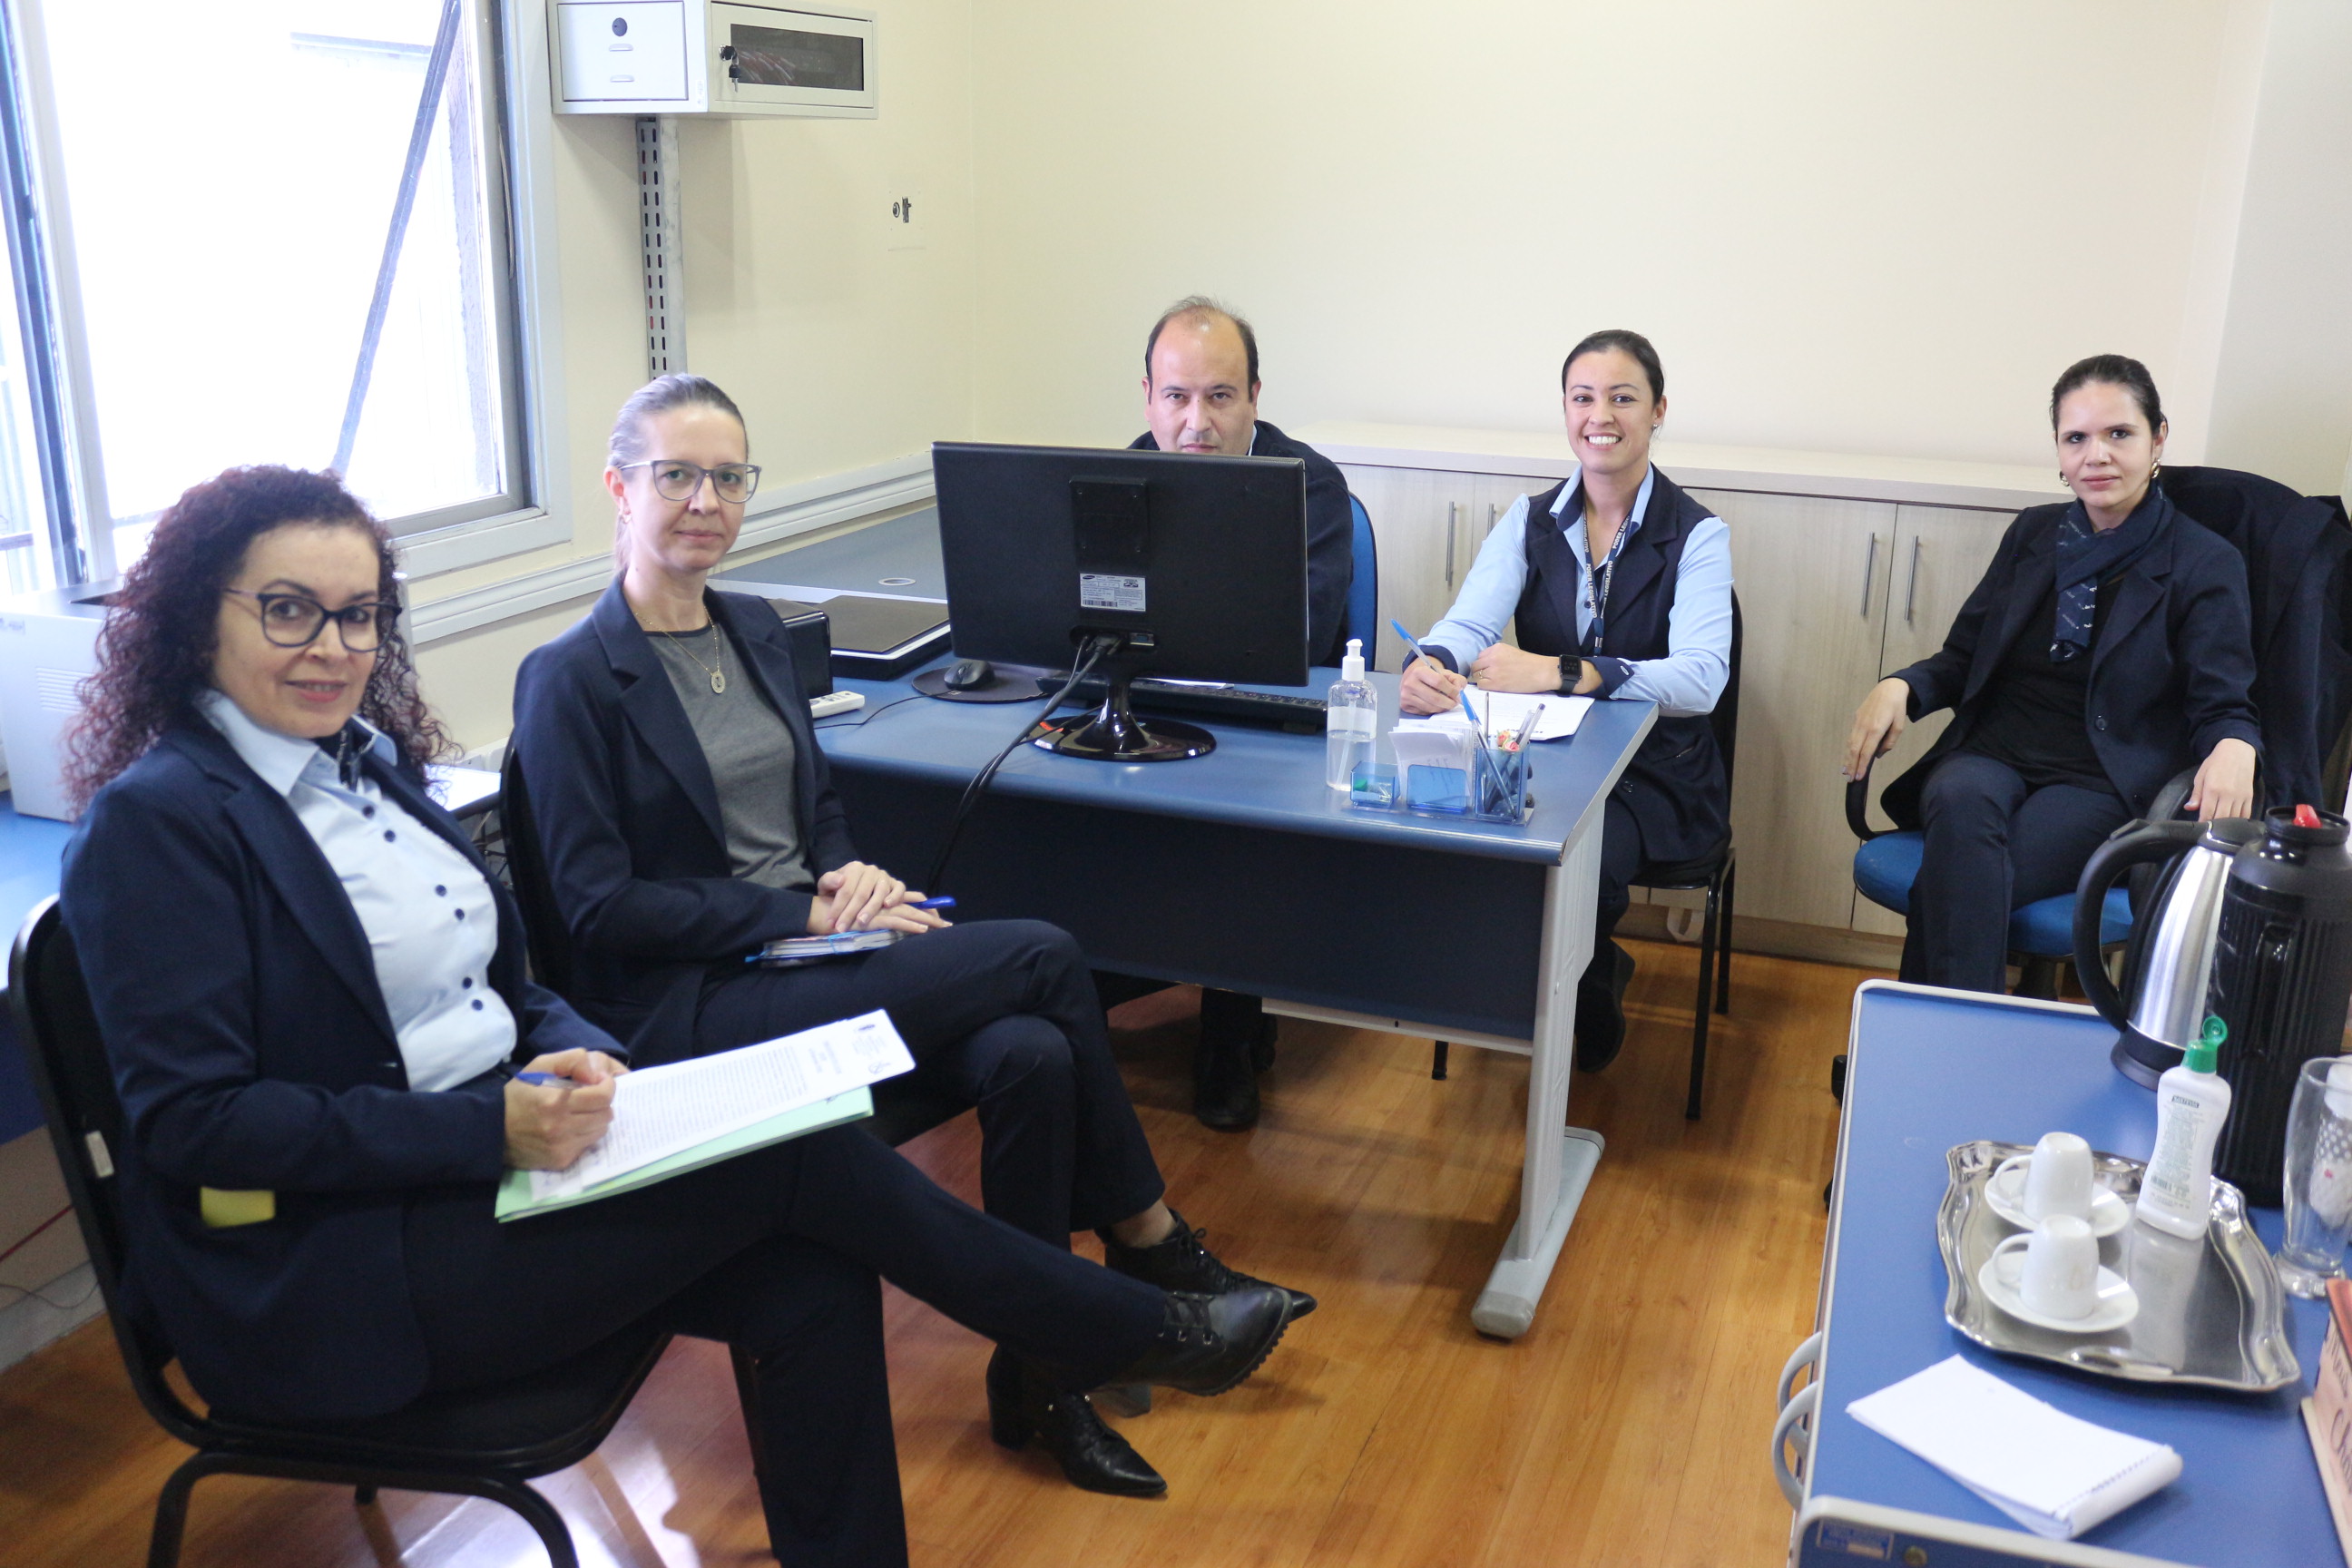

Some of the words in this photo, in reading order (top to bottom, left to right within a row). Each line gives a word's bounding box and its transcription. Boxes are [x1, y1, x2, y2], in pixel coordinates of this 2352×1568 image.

[1612, 532, 1623, 549] PODER
[1604, 560, 1613, 596] LEGISLATIVO
[1588, 582, 1598, 619] LEGISLATIVO
